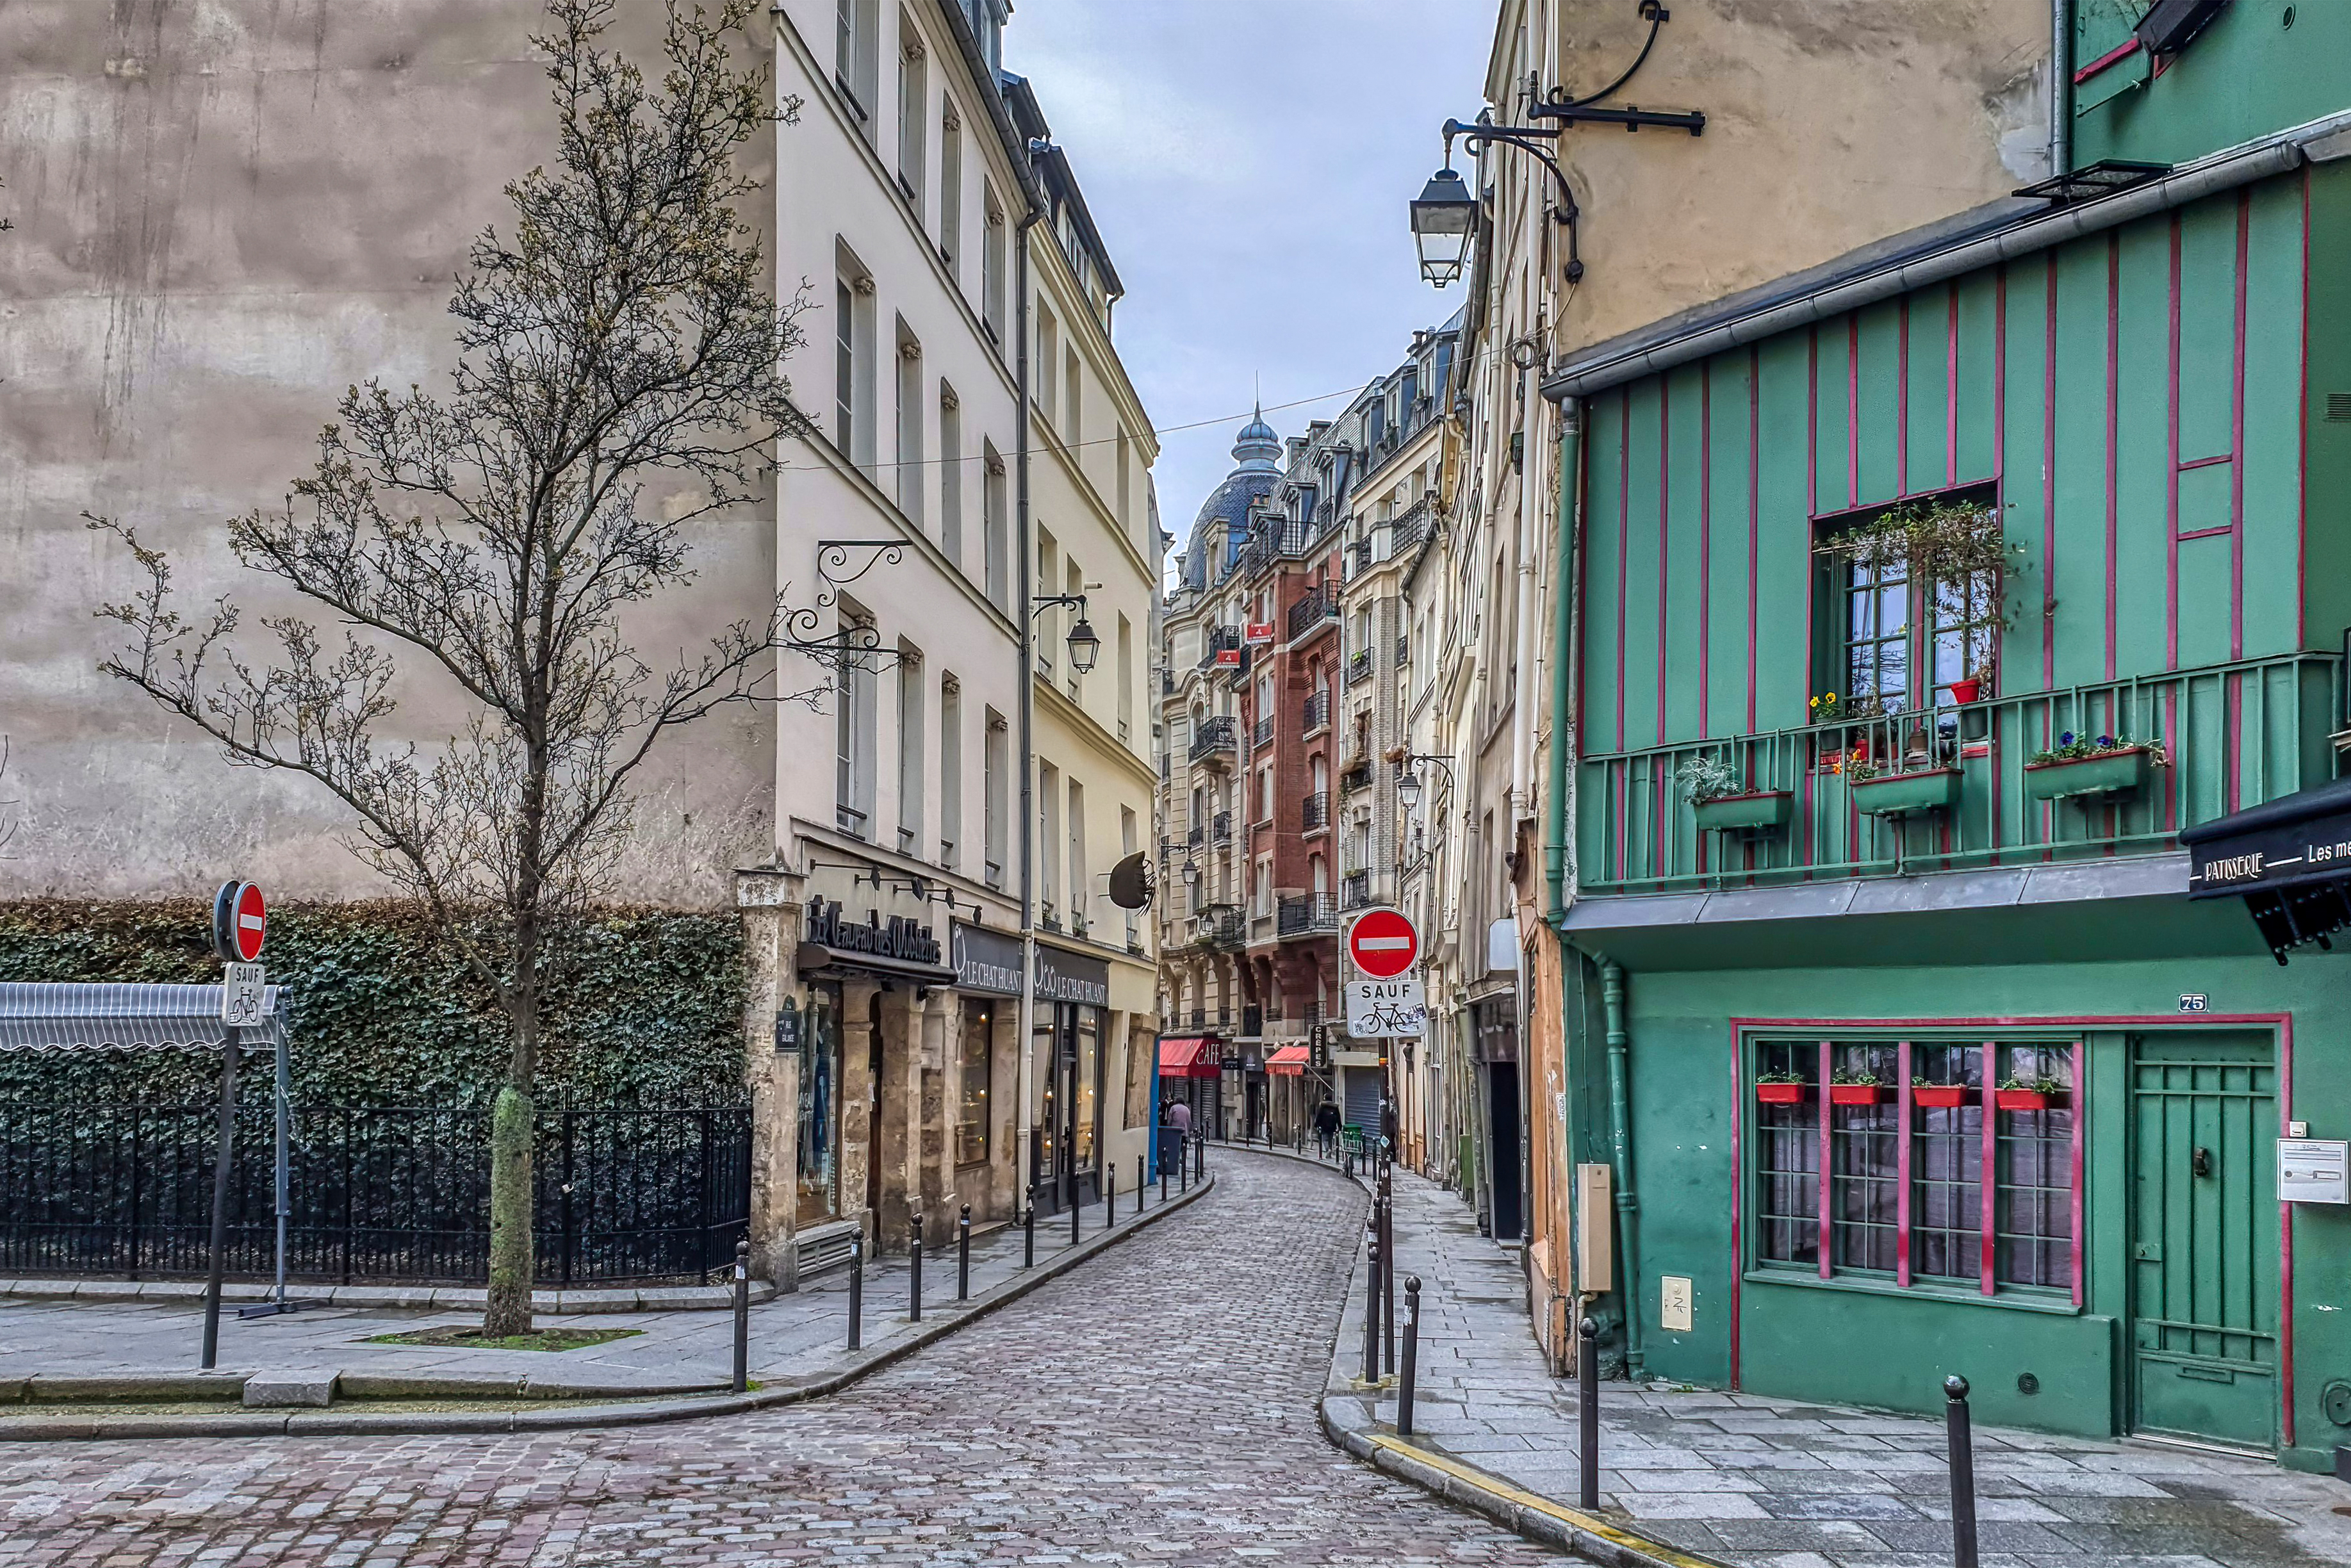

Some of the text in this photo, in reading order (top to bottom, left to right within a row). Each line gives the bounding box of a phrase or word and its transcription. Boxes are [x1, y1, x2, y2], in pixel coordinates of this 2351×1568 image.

[2205, 852, 2263, 882] PATISSERIE
[2308, 844, 2332, 863] Les
[235, 967, 259, 983] SAUF
[967, 960, 1023, 992] LE CHAT HUANT
[1057, 976, 1106, 1004] LE CHAT HUANT
[1361, 984, 1411, 999] SAUF
[2181, 996, 2204, 1010] 75
